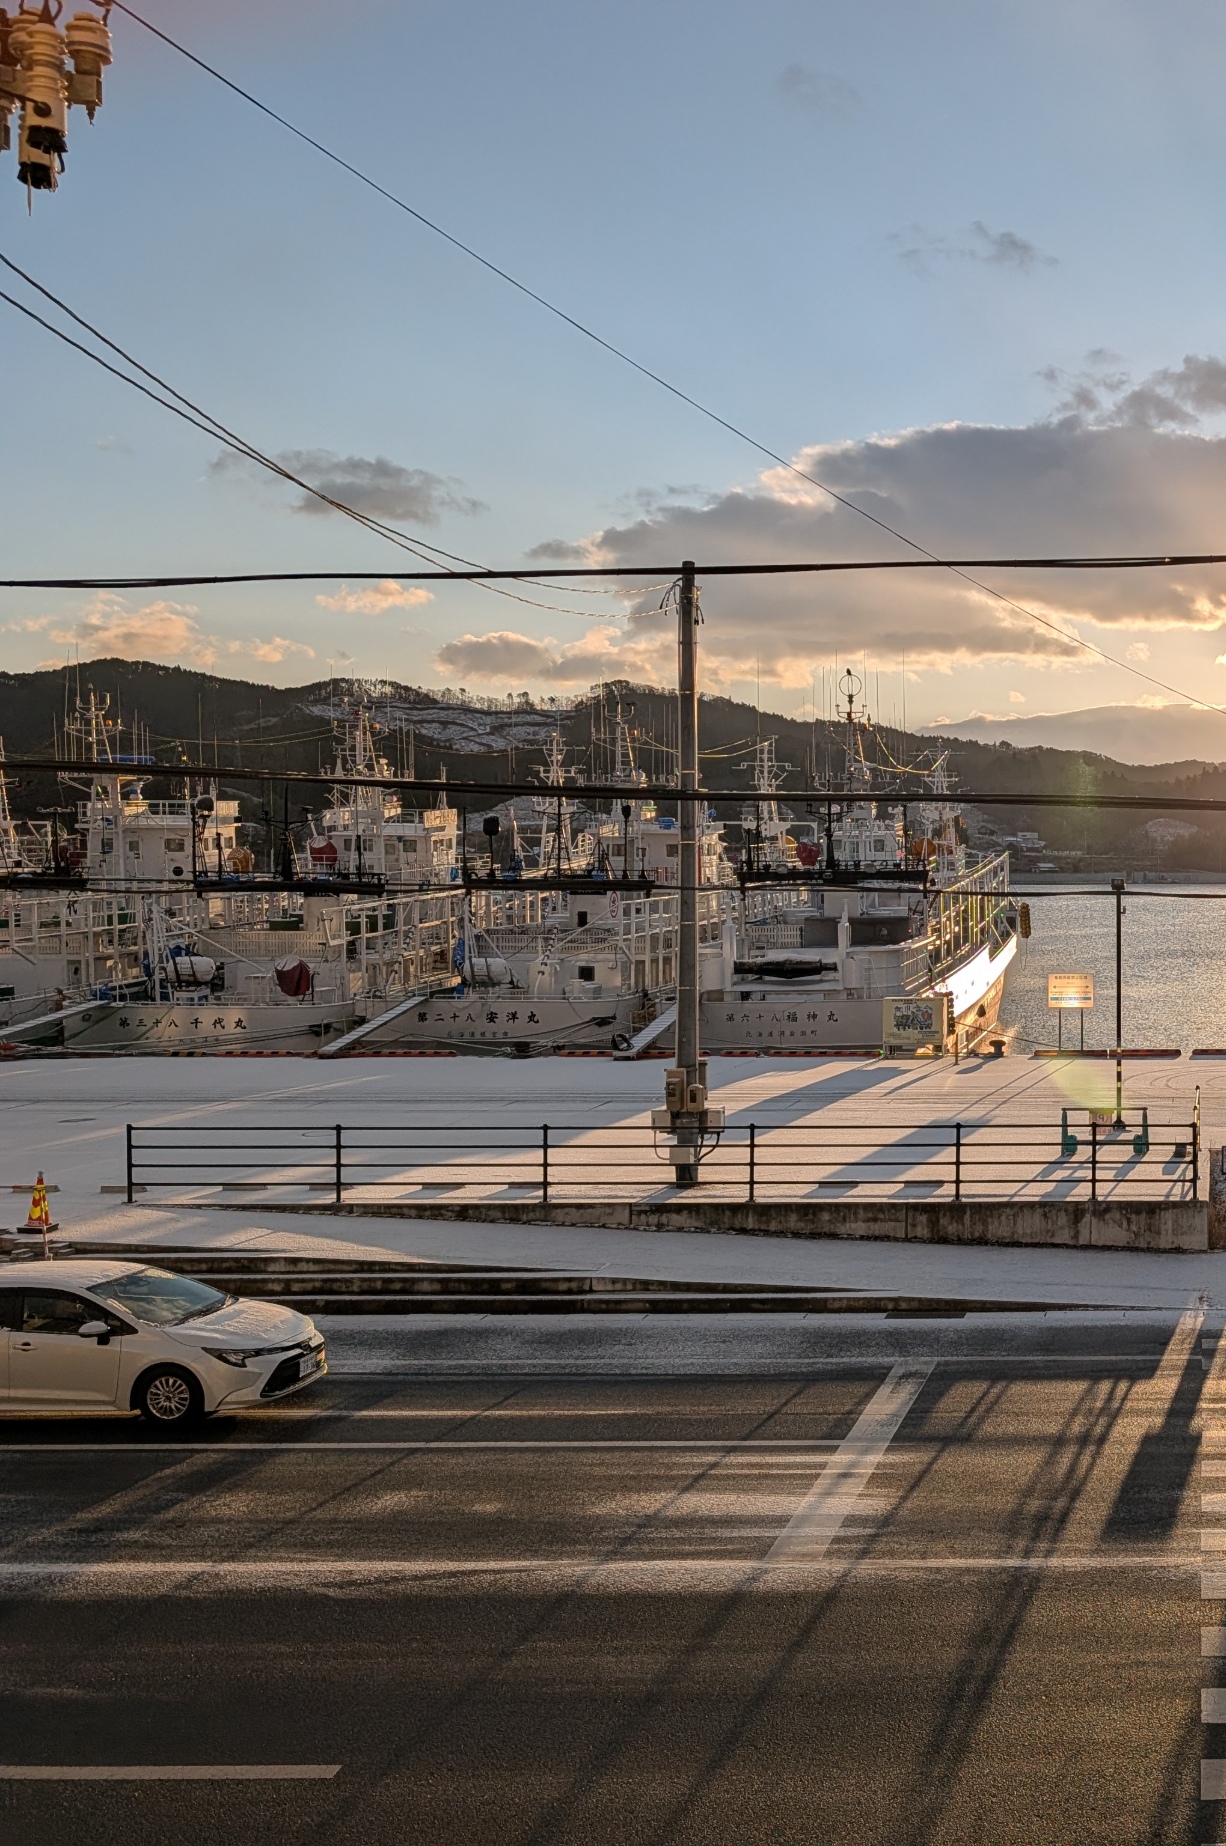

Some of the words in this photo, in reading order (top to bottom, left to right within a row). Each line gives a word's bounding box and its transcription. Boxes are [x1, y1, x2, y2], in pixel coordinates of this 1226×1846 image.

[118, 1017, 247, 1030] 第三十八千代丸
[417, 1011, 540, 1024] 第二十八安洋丸
[725, 1011, 839, 1023] 第六十八福神丸
